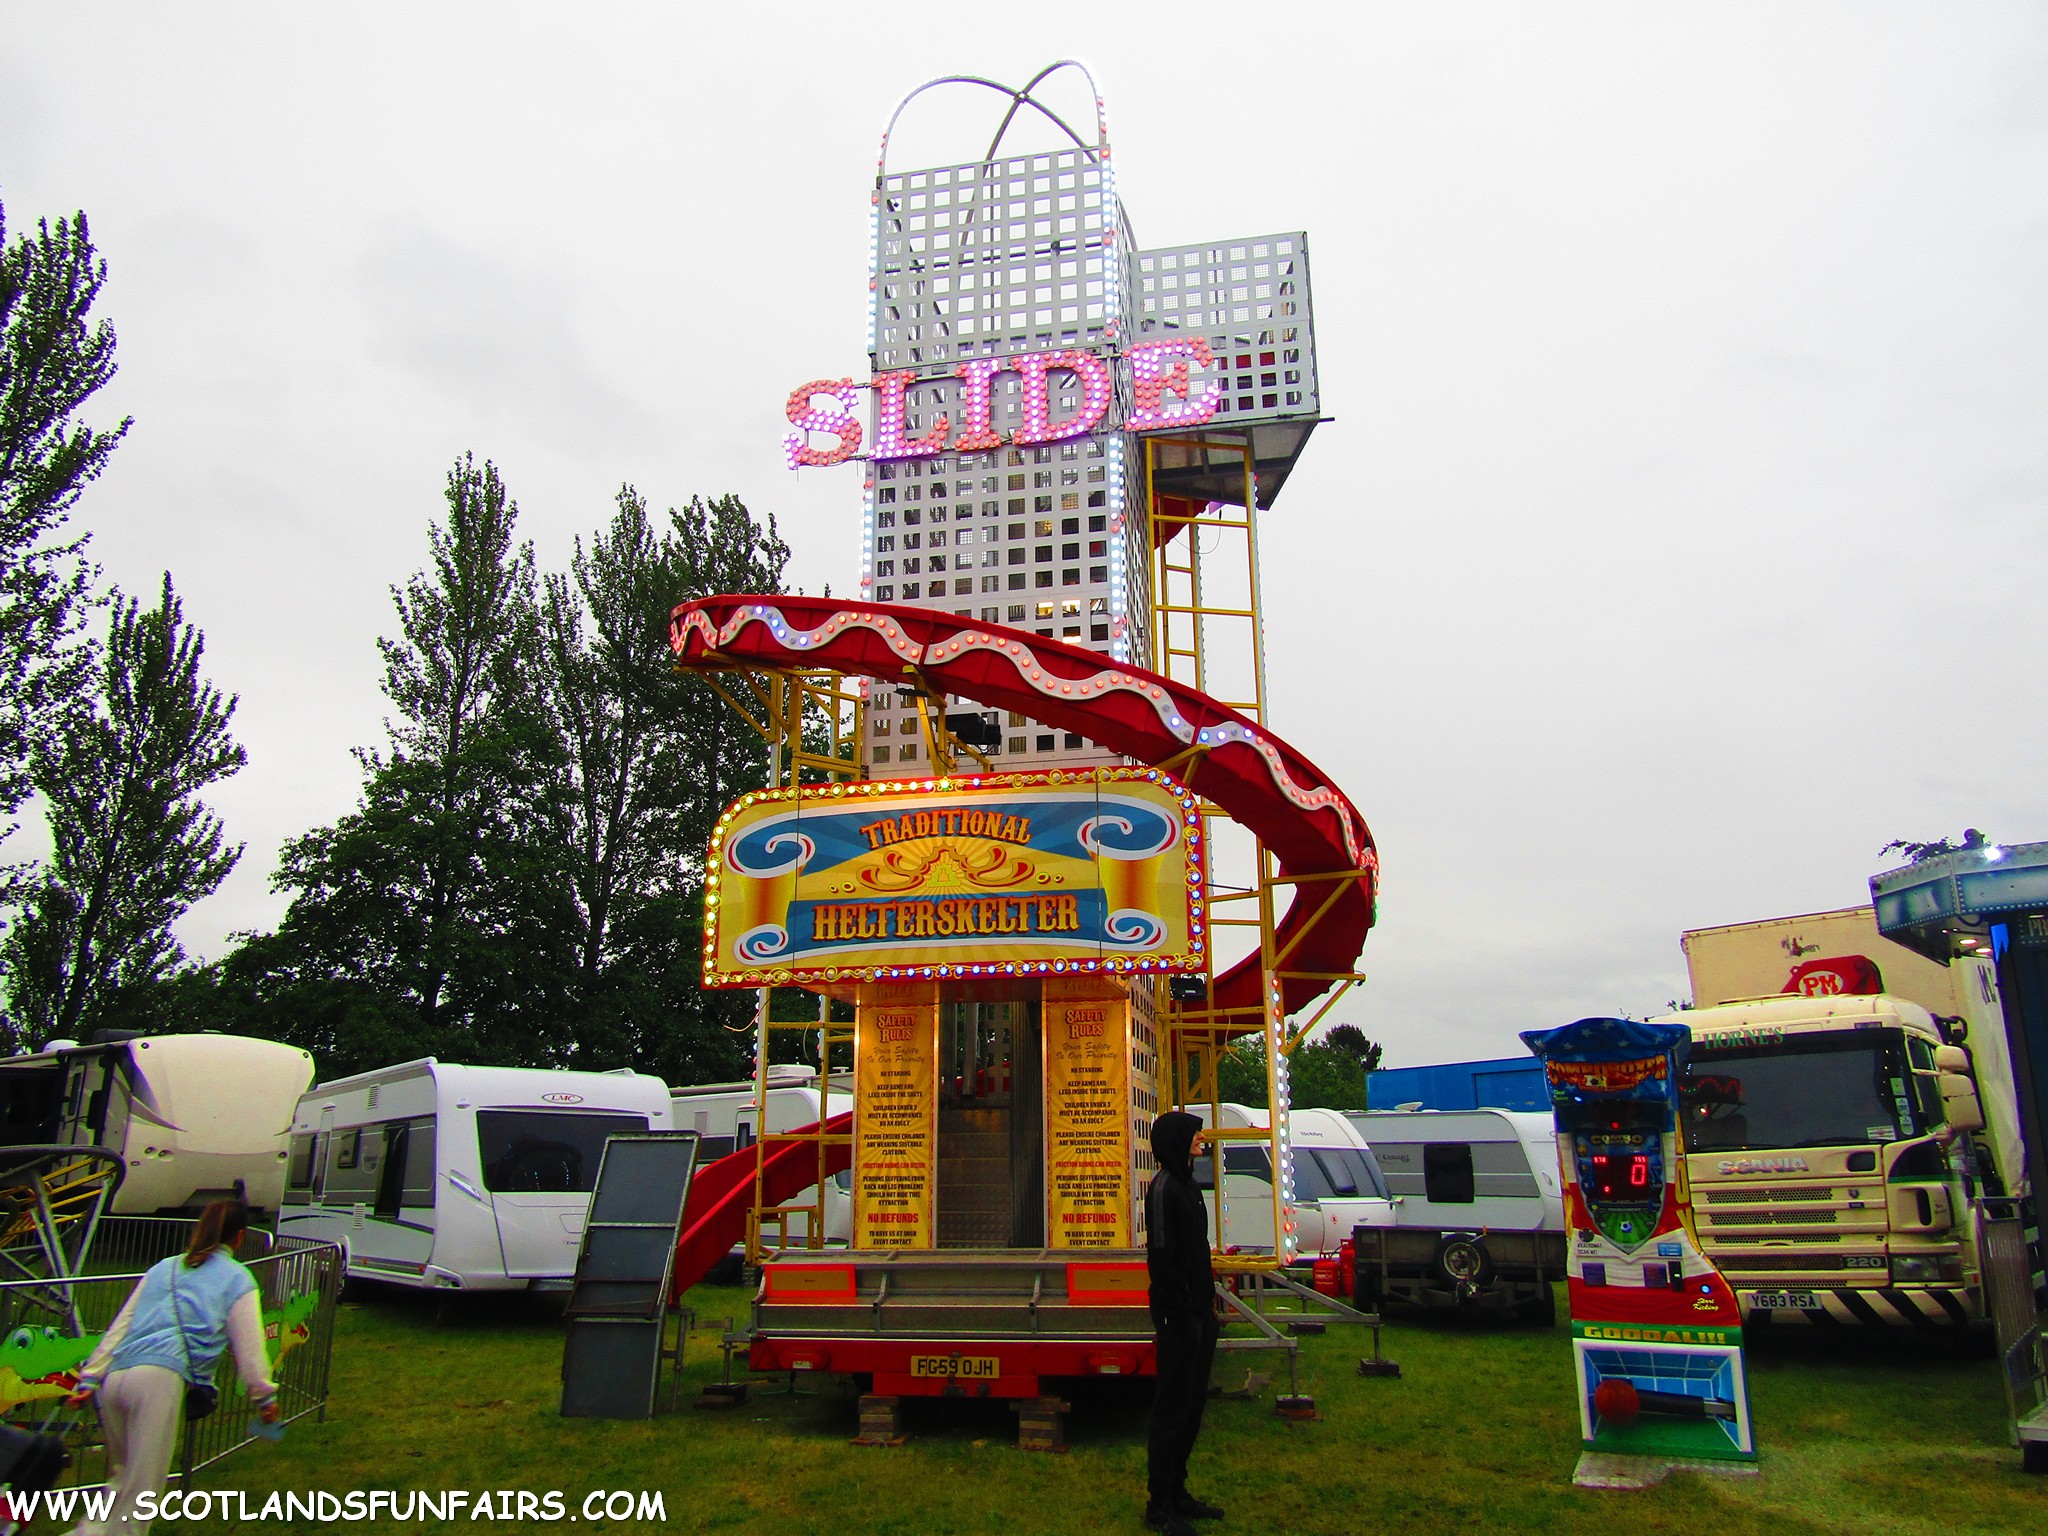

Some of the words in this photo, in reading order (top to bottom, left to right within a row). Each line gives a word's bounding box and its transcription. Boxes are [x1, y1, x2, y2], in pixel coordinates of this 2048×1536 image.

[781, 335, 1223, 470] SLIDE
[860, 808, 1032, 850] TRADITIONAL
[812, 893, 1080, 942] HELTERSKELTER
[1803, 974, 1839, 997] PM
[877, 1014, 917, 1029] SAFETY
[1066, 1009, 1107, 1024] SAFETY
[880, 1028, 913, 1044] RULES
[1069, 1023, 1104, 1039] RULES
[1703, 1026, 1784, 1050] HORNE'S
[894, 1046, 919, 1055] Safety
[1085, 1042, 1111, 1051] Safety
[895, 1055, 926, 1064] Priority
[1087, 1051, 1118, 1060] Priority
[1718, 1156, 1809, 1175] SCANIA
[1632, 1164, 1646, 1185] 0
[868, 1213, 878, 1223] NO
[881, 1213, 919, 1223] REFUNDS
[1063, 1213, 1074, 1224] NO
[1077, 1213, 1116, 1224] REFUNDS
[1846, 1257, 1882, 1268] 220
[1692, 1303, 1719, 1311] Kicking
[1752, 1294, 1786, 1307] Y683
[1790, 1295, 1817, 1307] RSA
[1584, 1326, 1726, 1344] GOOOAL!!!
[917, 1358, 959, 1376] FG59
[962, 1359, 993, 1376] OJH
